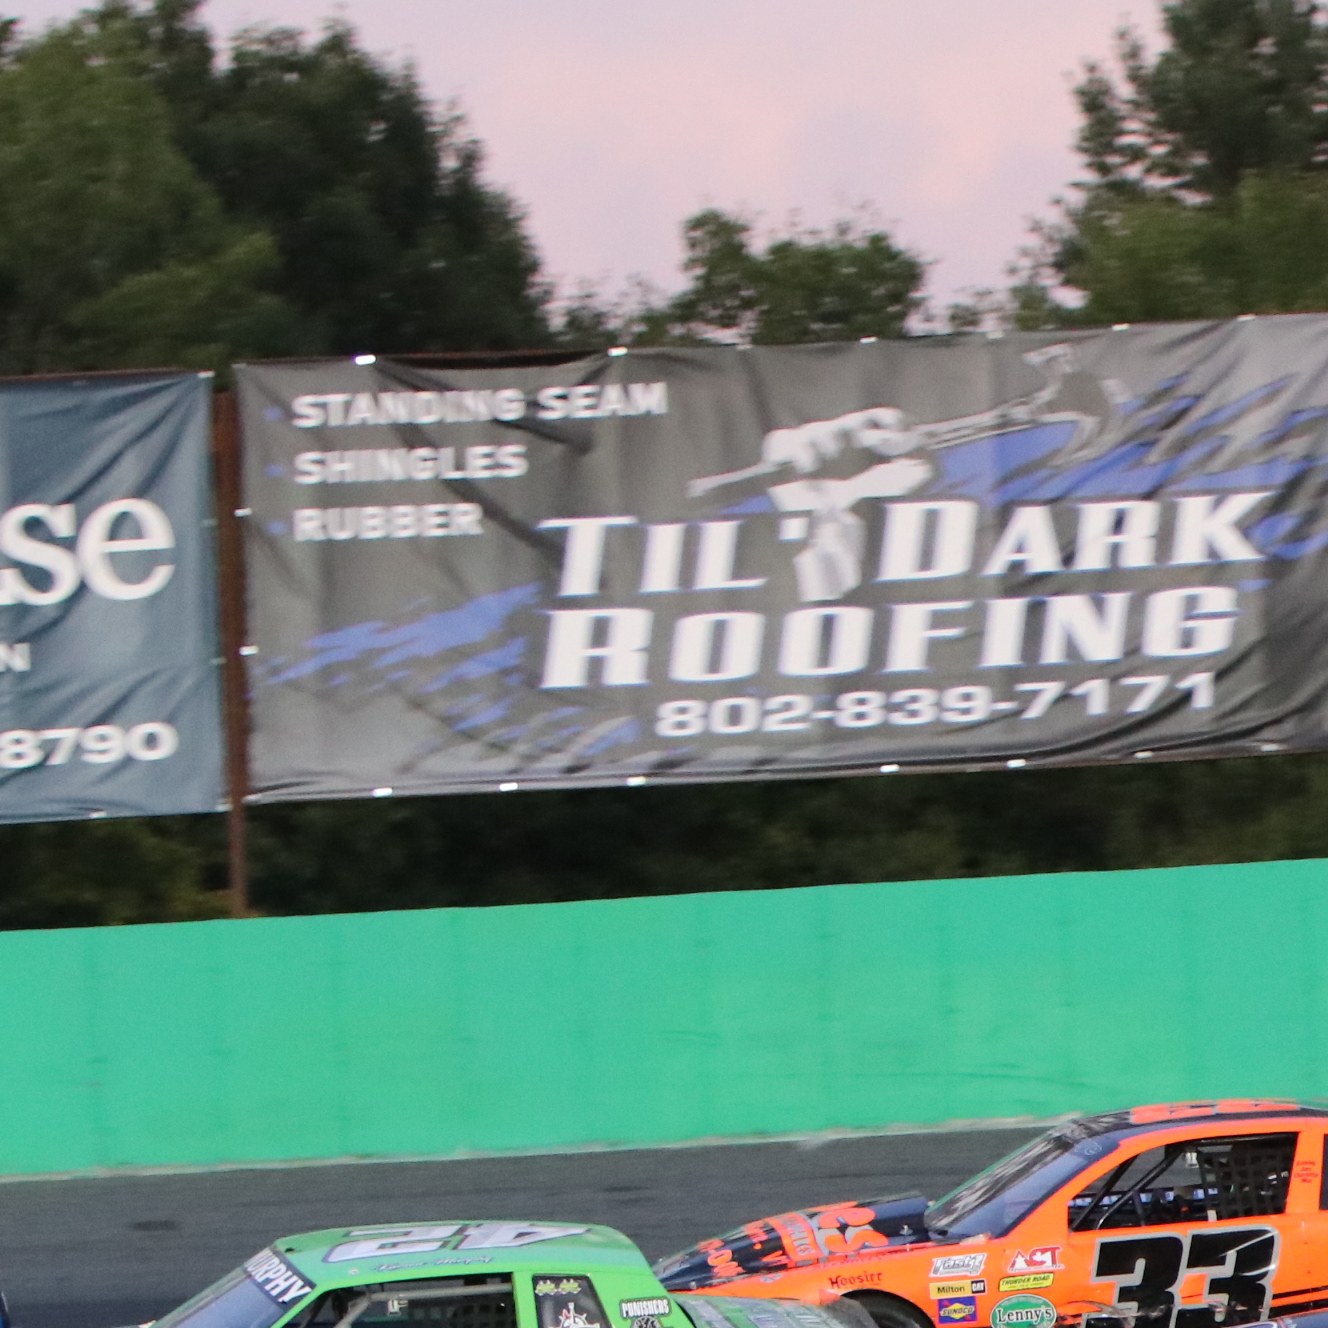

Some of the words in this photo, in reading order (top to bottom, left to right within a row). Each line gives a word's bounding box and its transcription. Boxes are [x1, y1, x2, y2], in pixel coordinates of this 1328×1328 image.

[293, 389, 525, 428] STANDING
[536, 382, 668, 419] SEAM
[294, 444, 528, 484] SHINGLES
[293, 502, 484, 542] RUBBER
[872, 491, 1280, 583] DARK
[538, 585, 1241, 690] ROOFING
[654, 671, 1215, 738] 802-839-7171
[937, 1285, 965, 1294] Milton
[996, 1307, 1054, 1324] Lenny's
